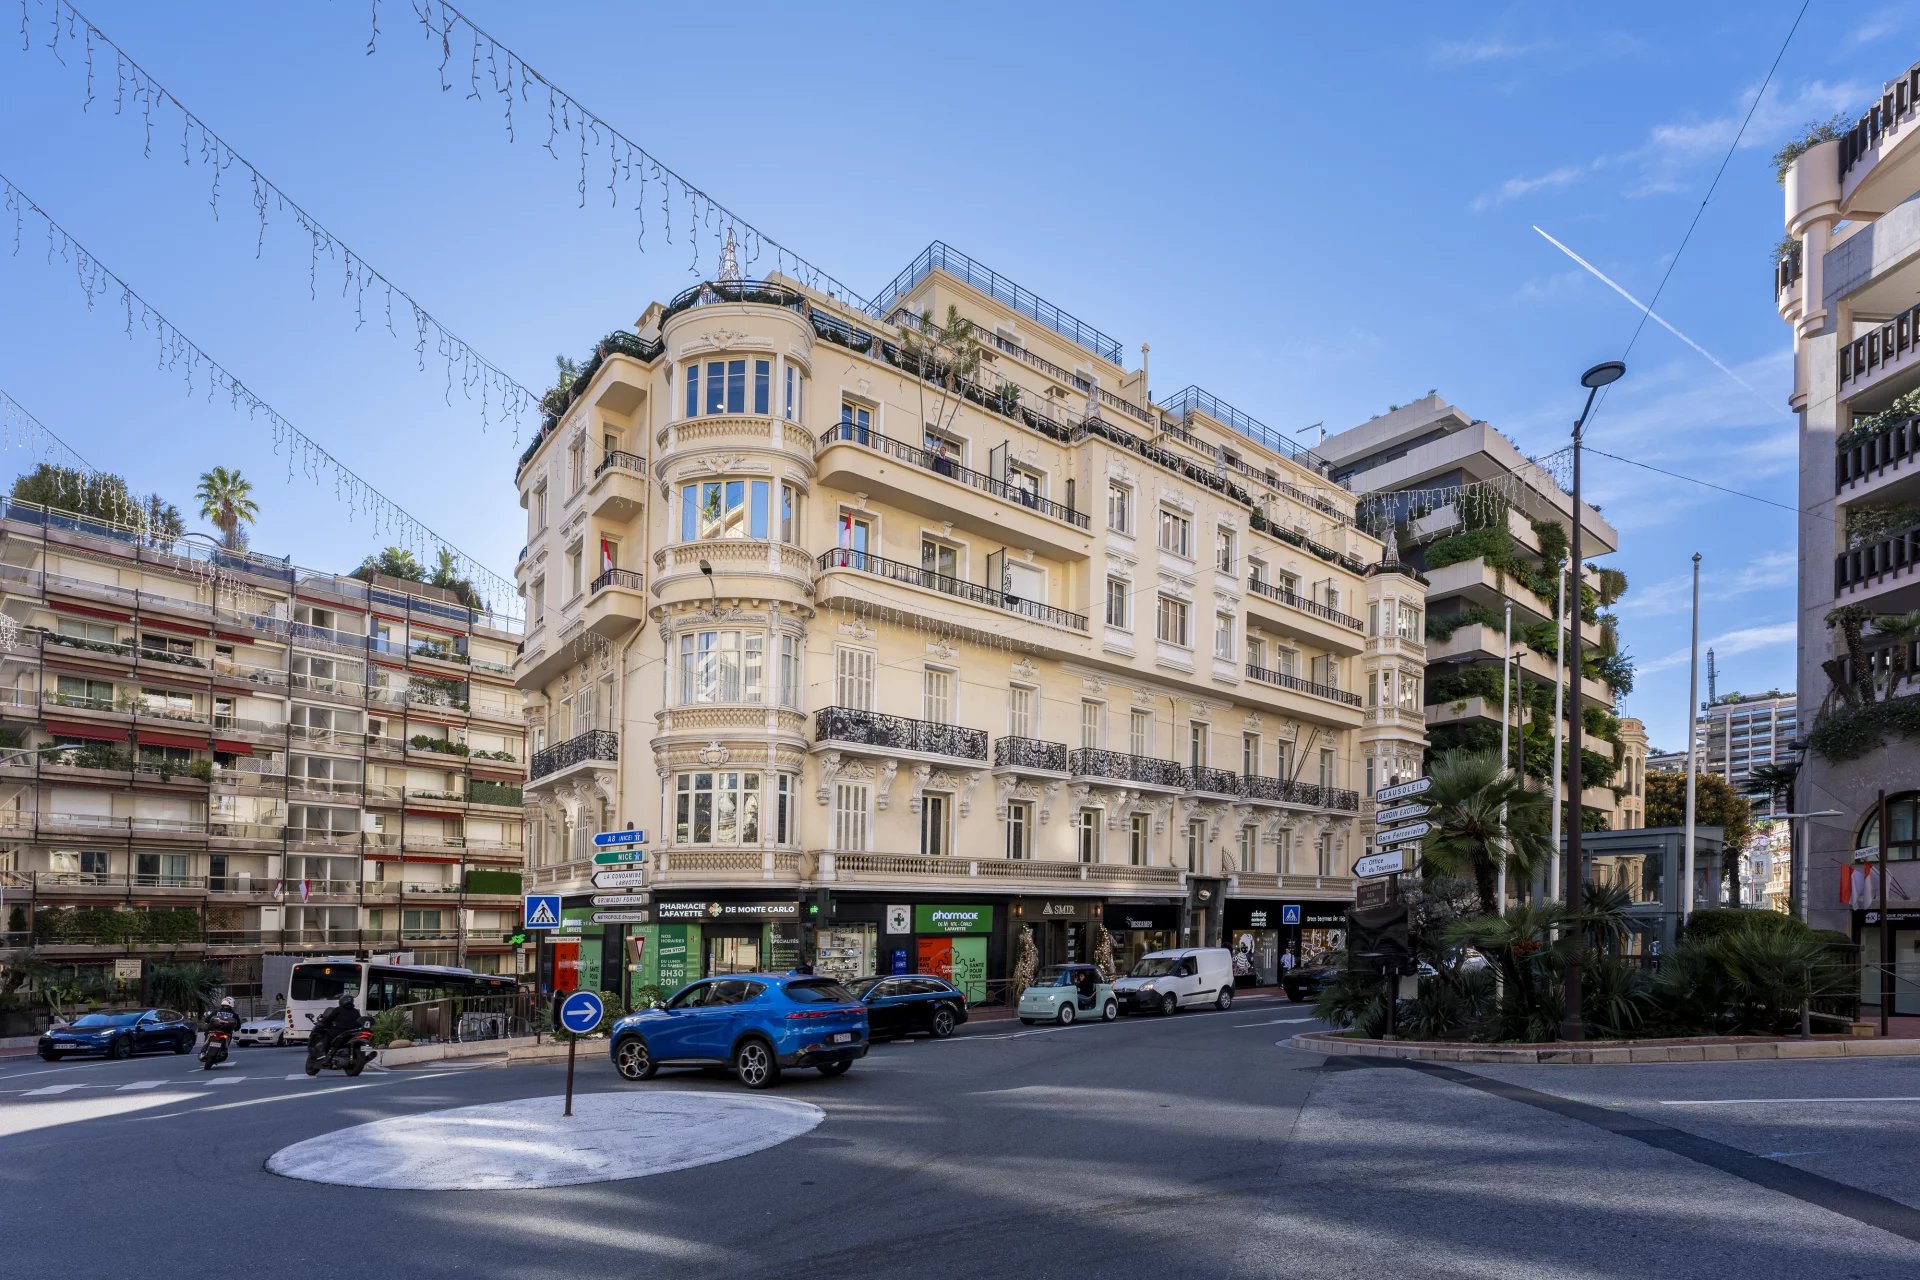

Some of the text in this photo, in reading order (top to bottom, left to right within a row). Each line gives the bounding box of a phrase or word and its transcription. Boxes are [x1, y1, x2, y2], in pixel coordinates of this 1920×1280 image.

[1378, 783, 1424, 800] BEAUSOLEIL
[1379, 810, 1398, 821] JARDIN
[1378, 826, 1424, 842] Gare Ferroviaire
[617, 853, 633, 861] NICE
[1368, 858, 1383, 866] Office
[1376, 863, 1399, 872] Tourisme
[1054, 905, 1076, 915] SMIR
[932, 909, 979, 921] pharmacie
[660, 969, 684, 977] 8H30
[660, 978, 678, 986] 20H
